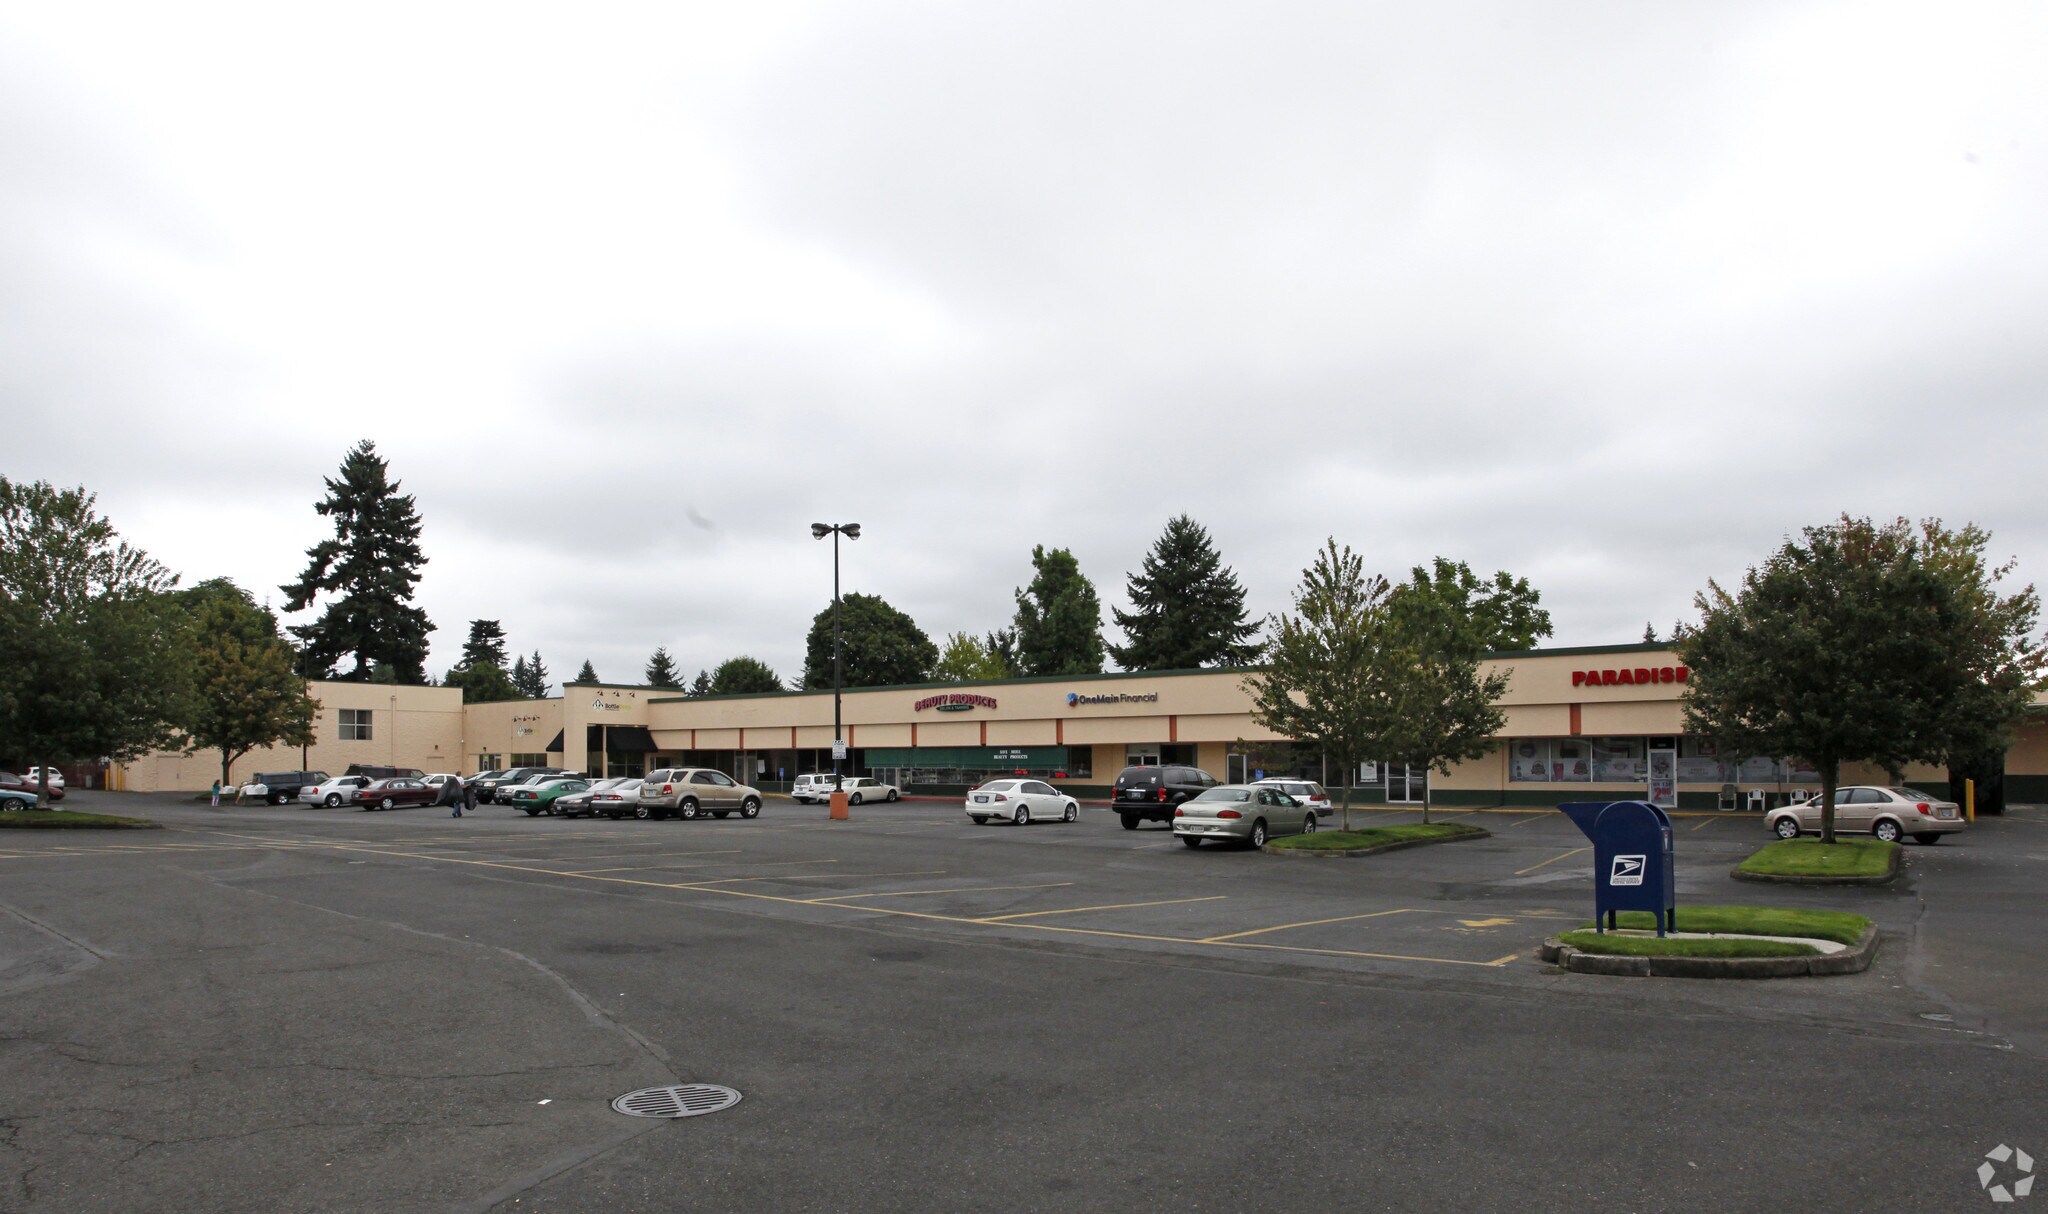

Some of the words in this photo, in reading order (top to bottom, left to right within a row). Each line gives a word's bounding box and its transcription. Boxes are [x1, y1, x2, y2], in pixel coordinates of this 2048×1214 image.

[1572, 666, 1689, 687] PARADISE
[914, 694, 948, 712] BEAUTY
[948, 693, 998, 710] PRODUCTS
[1079, 693, 1120, 704] OneMain
[1120, 692, 1158, 703] Financial
